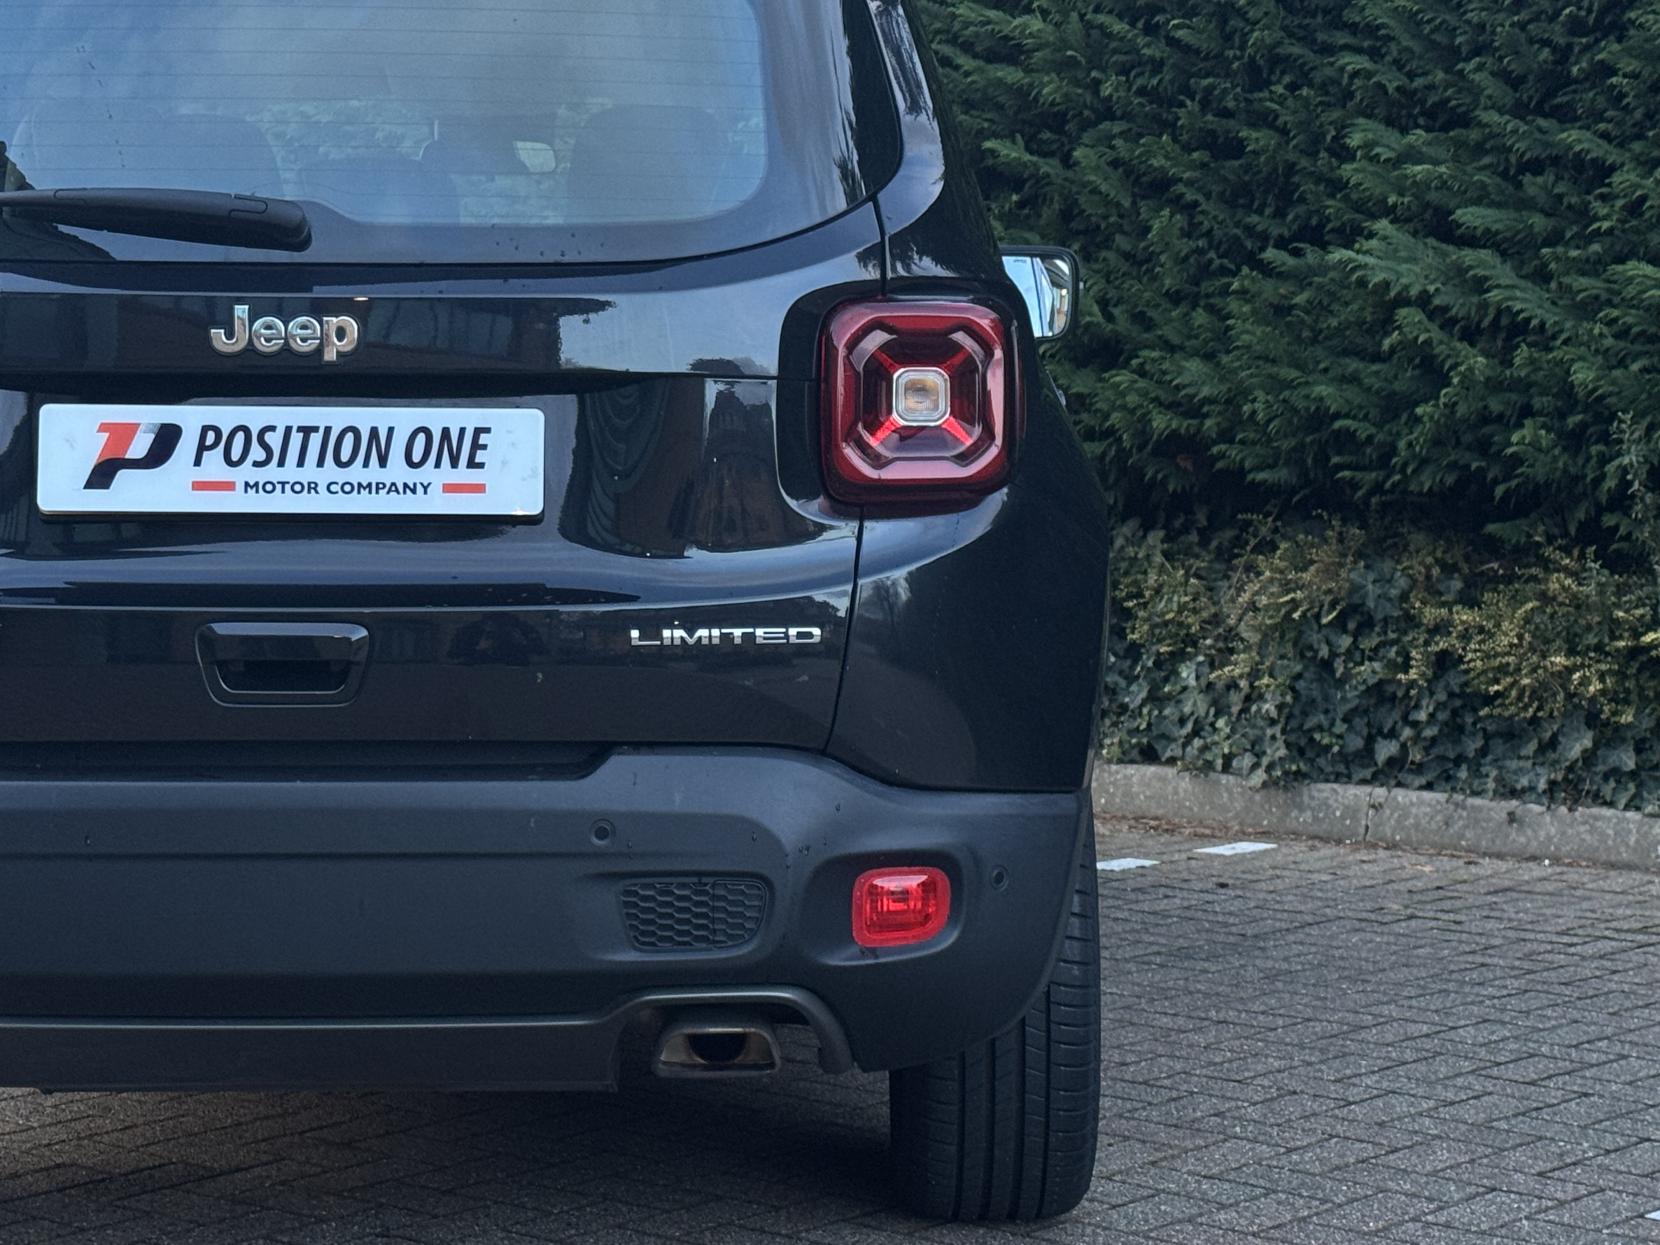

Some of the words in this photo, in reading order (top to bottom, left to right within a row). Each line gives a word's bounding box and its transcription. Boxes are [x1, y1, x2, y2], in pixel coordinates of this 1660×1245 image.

[209, 304, 359, 363] Jeep
[193, 424, 394, 469] POSITION
[404, 426, 492, 470] ONE
[243, 481, 321, 496] MOTOR
[326, 482, 432, 496] COMPANY
[630, 627, 822, 646] LIMITED
